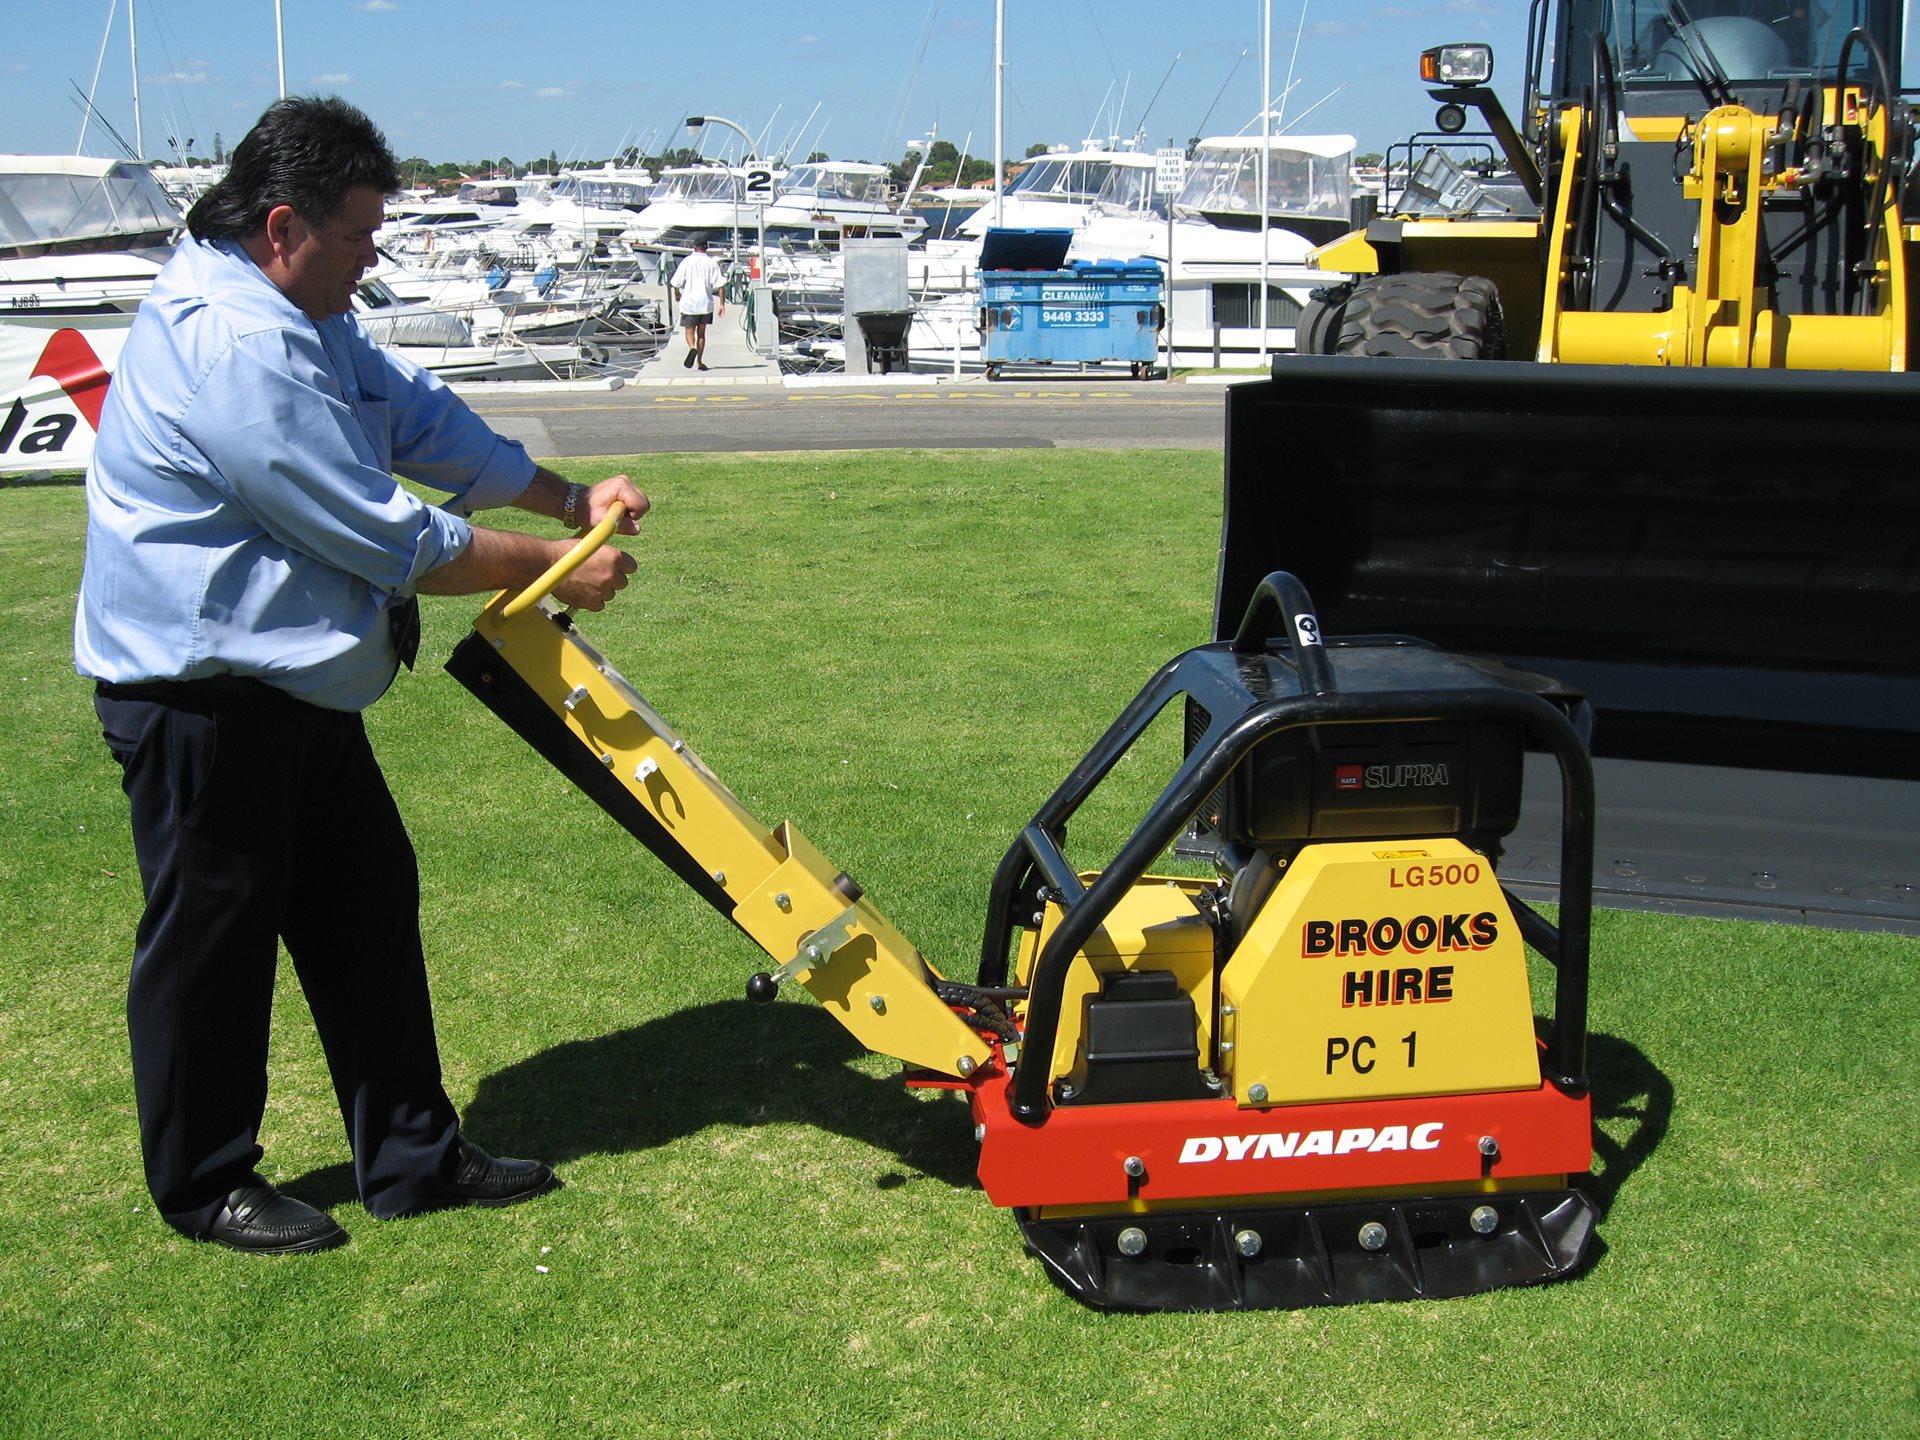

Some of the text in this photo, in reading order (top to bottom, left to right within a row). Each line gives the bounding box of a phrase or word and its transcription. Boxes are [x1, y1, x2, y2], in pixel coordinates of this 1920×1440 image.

[747, 170, 772, 192] 2
[1042, 291, 1105, 301] CLEANAWAY
[1042, 311, 1105, 322] 9449 3333
[787, 391, 1134, 400] PARKING
[1364, 763, 1450, 789] SUPRA
[1389, 863, 1480, 889] LG500
[1301, 911, 1499, 959] BROOKS
[1341, 965, 1455, 1009] HIRE
[1325, 1030, 1417, 1075] PC 1
[1177, 1122, 1445, 1164] DYNAPAC
